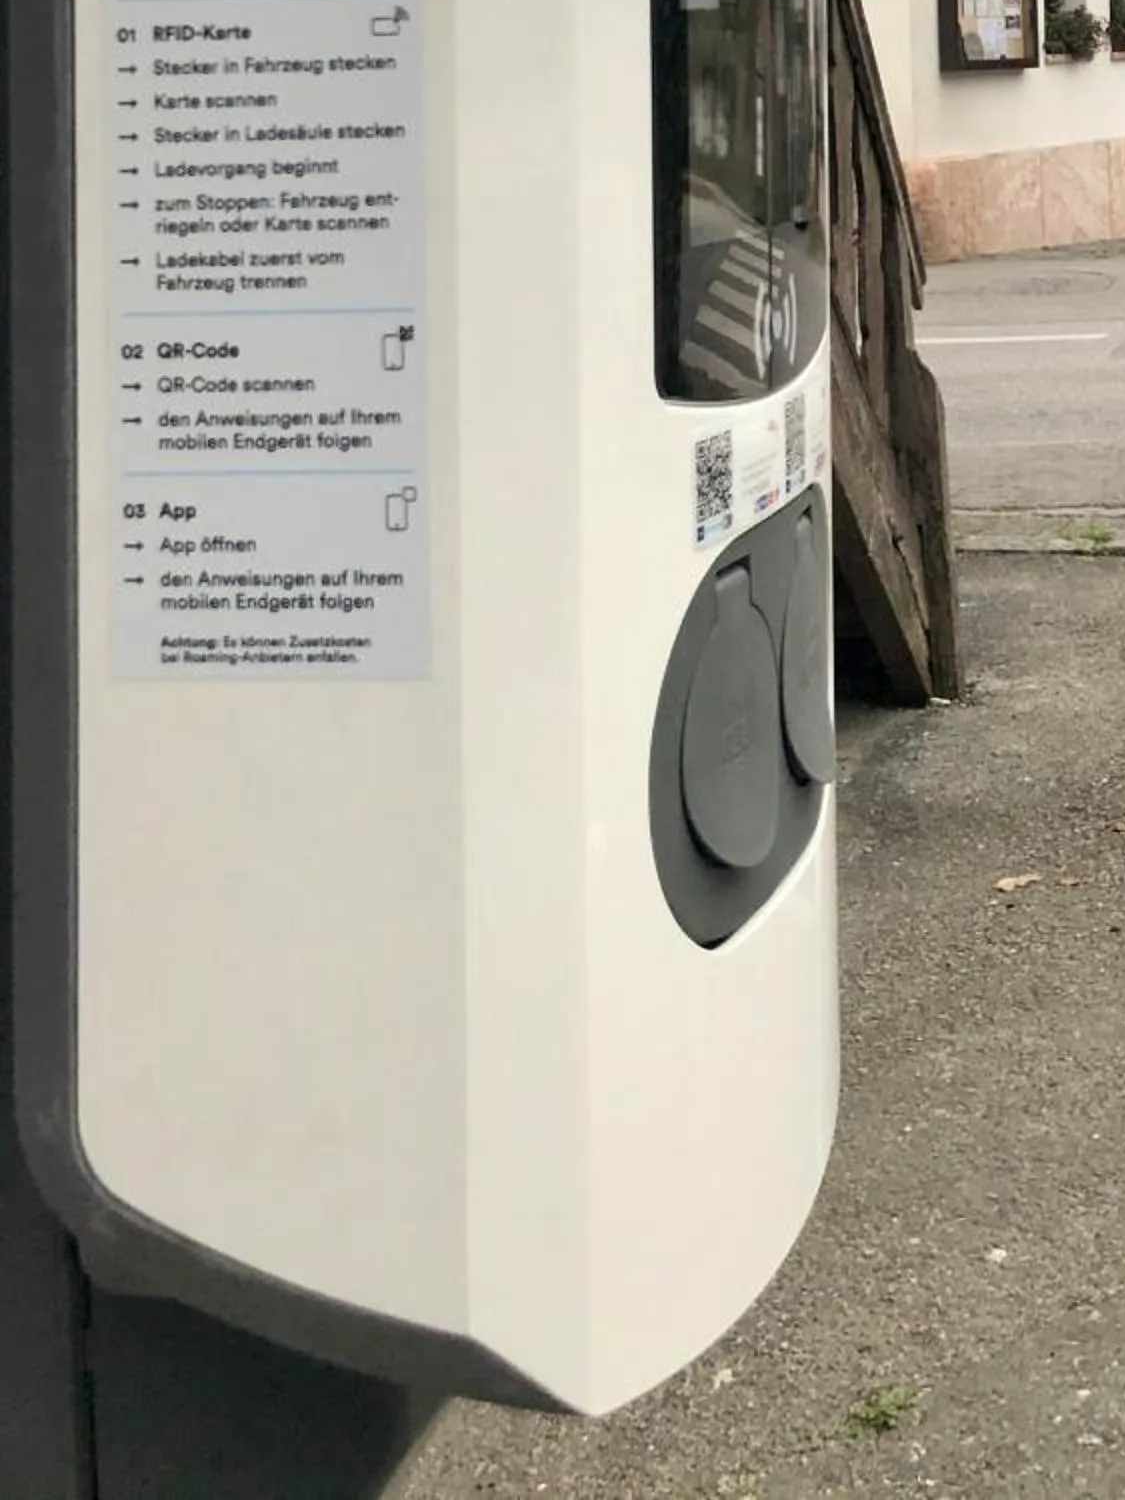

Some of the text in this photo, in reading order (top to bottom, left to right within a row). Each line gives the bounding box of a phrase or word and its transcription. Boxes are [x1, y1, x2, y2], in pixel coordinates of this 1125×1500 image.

[117, 26, 251, 42] 01 RFID-Karte
[154, 55, 397, 76] Stecker in Fahrzeug stecken
[154, 94, 278, 109] Karte scannen
[154, 123, 405, 143] Stecker in Ladesäule stecken
[154, 159, 339, 179] Ladevorgang beginnt
[155, 192, 399, 213] zum Stoppen: Fahrzeug ent-
[155, 215, 389, 238] riegeln oder Karte scannen
[156, 252, 344, 268] Ladekabel zuerst vom
[157, 275, 307, 293] Fahrzeug trennen
[121, 343, 239, 359] 02 QR-Code
[158, 377, 315, 393] QR-Code scannen
[158, 409, 401, 429] den Anweisungen auf Ihrem
[158, 432, 372, 452] mobilen Endgerät folgen
[123, 502, 196, 522] 03 App
[160, 536, 256, 556] App öffnen
[160, 569, 403, 590] den Anweisungen auf Ihrem
[161, 593, 374, 612] mobilen Endgerät folgen
[241, 636, 285, 648] können
[289, 635, 371, 648] Zusatzkosten
